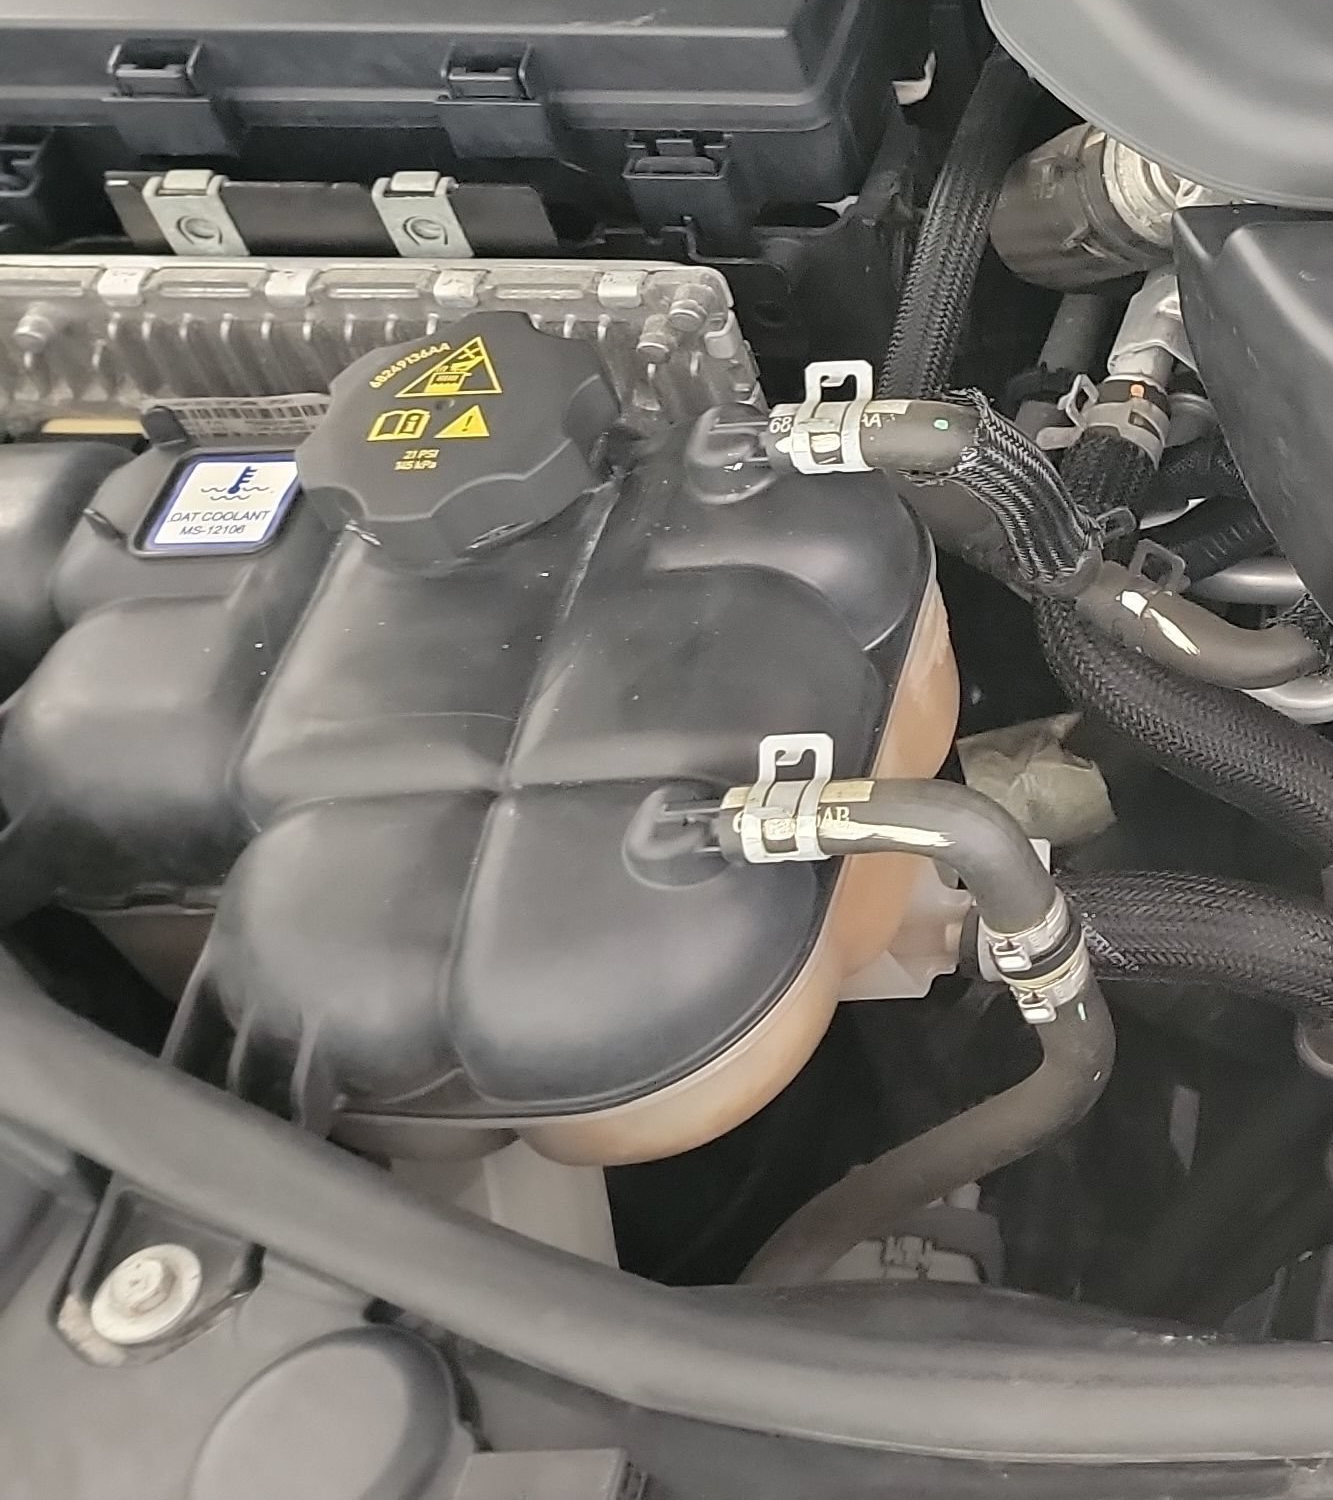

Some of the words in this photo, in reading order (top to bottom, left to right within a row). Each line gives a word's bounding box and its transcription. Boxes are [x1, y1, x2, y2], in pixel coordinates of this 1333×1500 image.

[417, 449, 440, 459] PSI
[170, 512, 200, 522] OAT
[201, 510, 271, 522] COOLANT
